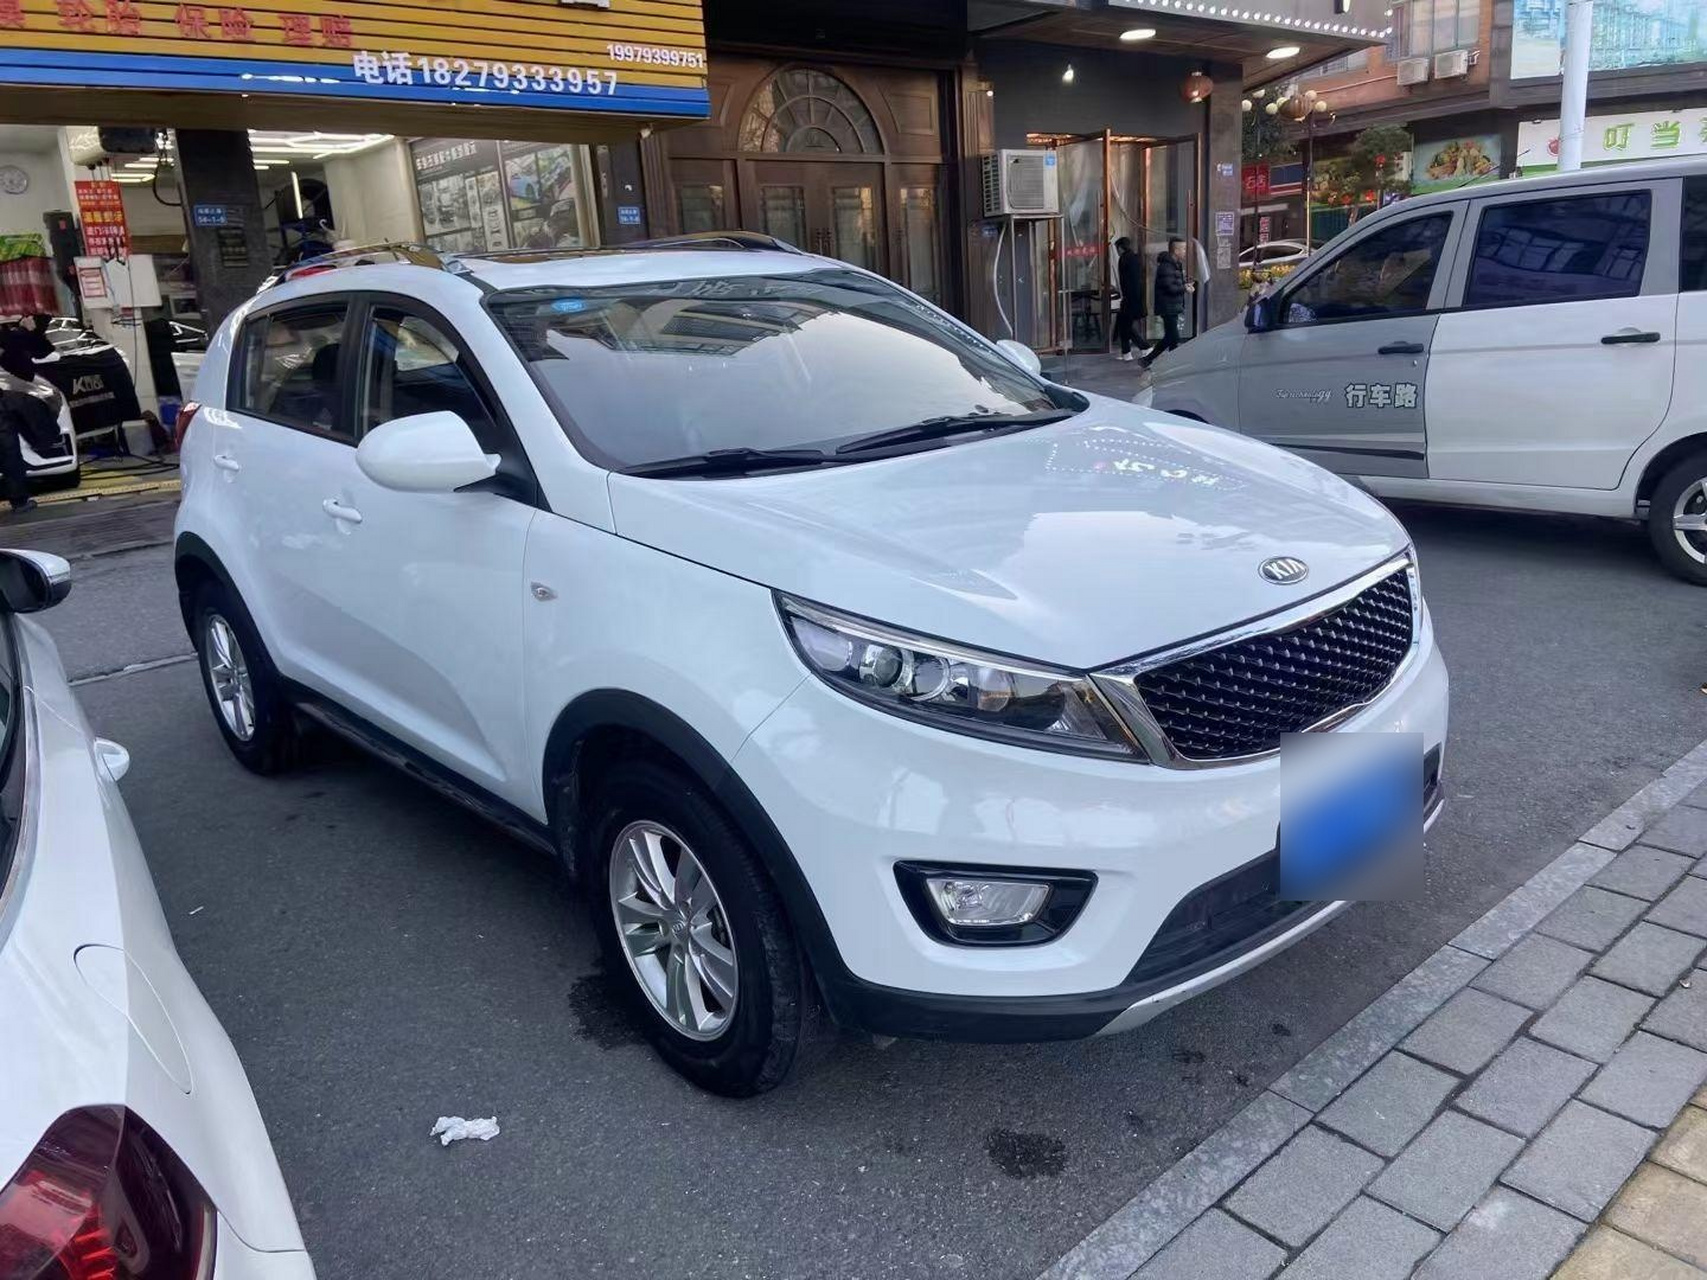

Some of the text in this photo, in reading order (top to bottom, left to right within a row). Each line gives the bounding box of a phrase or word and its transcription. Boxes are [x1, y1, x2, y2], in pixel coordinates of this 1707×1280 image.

[175, 3, 254, 39] 保险
[279, 13, 355, 48] 理赔
[607, 44, 704, 69] 19979399751
[1344, 382, 1419, 409] 行车路
[1264, 558, 1306, 581] KIA
